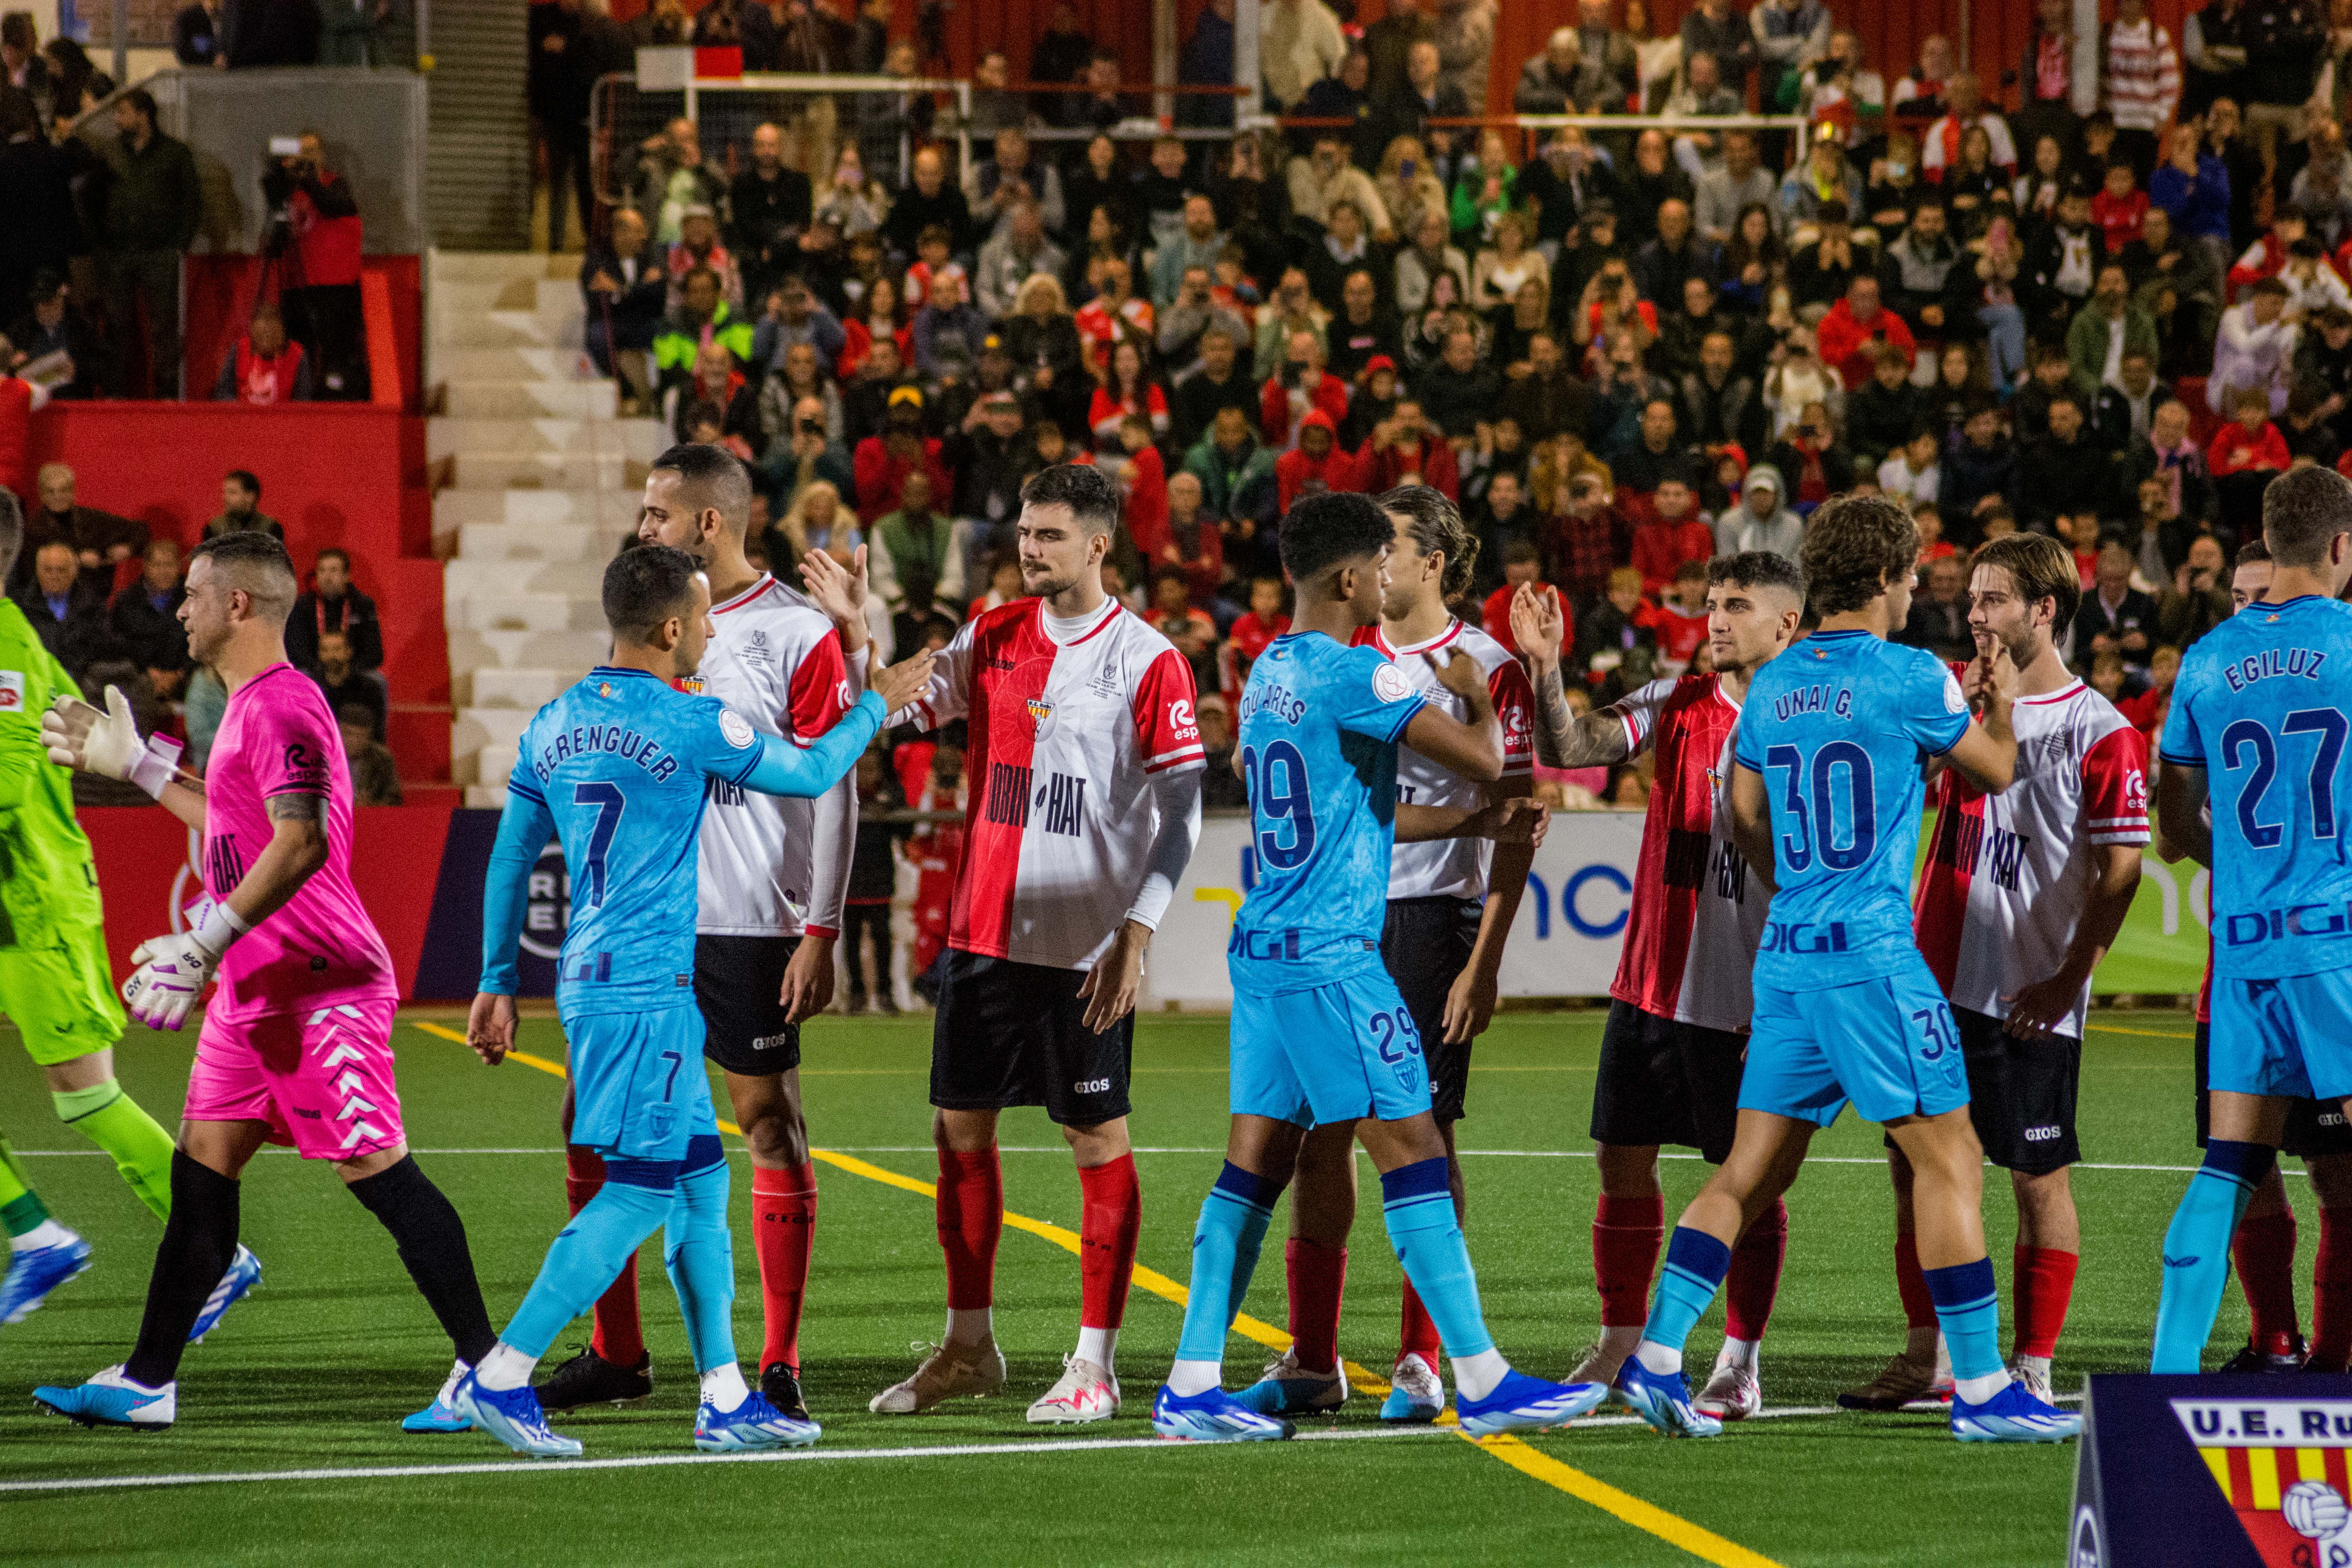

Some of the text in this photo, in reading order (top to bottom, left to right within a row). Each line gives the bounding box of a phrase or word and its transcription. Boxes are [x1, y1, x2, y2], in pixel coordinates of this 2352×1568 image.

[2225, 648, 2327, 693] EGILUZ
[1240, 684, 1307, 726] DU ARES
[1775, 685, 1853, 722] UNAI G.
[535, 725, 679, 788] BERENGUER
[2220, 707, 2350, 850] 27
[1045, 772, 1086, 838] HAT
[1765, 740, 1877, 873] 30
[211, 834, 244, 895] HAT
[573, 781, 626, 909] 7
[1991, 827, 2030, 893] HAT
[561, 952, 612, 982] GI
[1370, 1006, 1421, 1065] 29
[1913, 1002, 1959, 1061] 30
[660, 1051, 683, 1104] 7
[1074, 1077, 1110, 1094] GIOS
[2025, 1125, 2061, 1142] GIOS
[2192, 1409, 2284, 1438] U.E.
